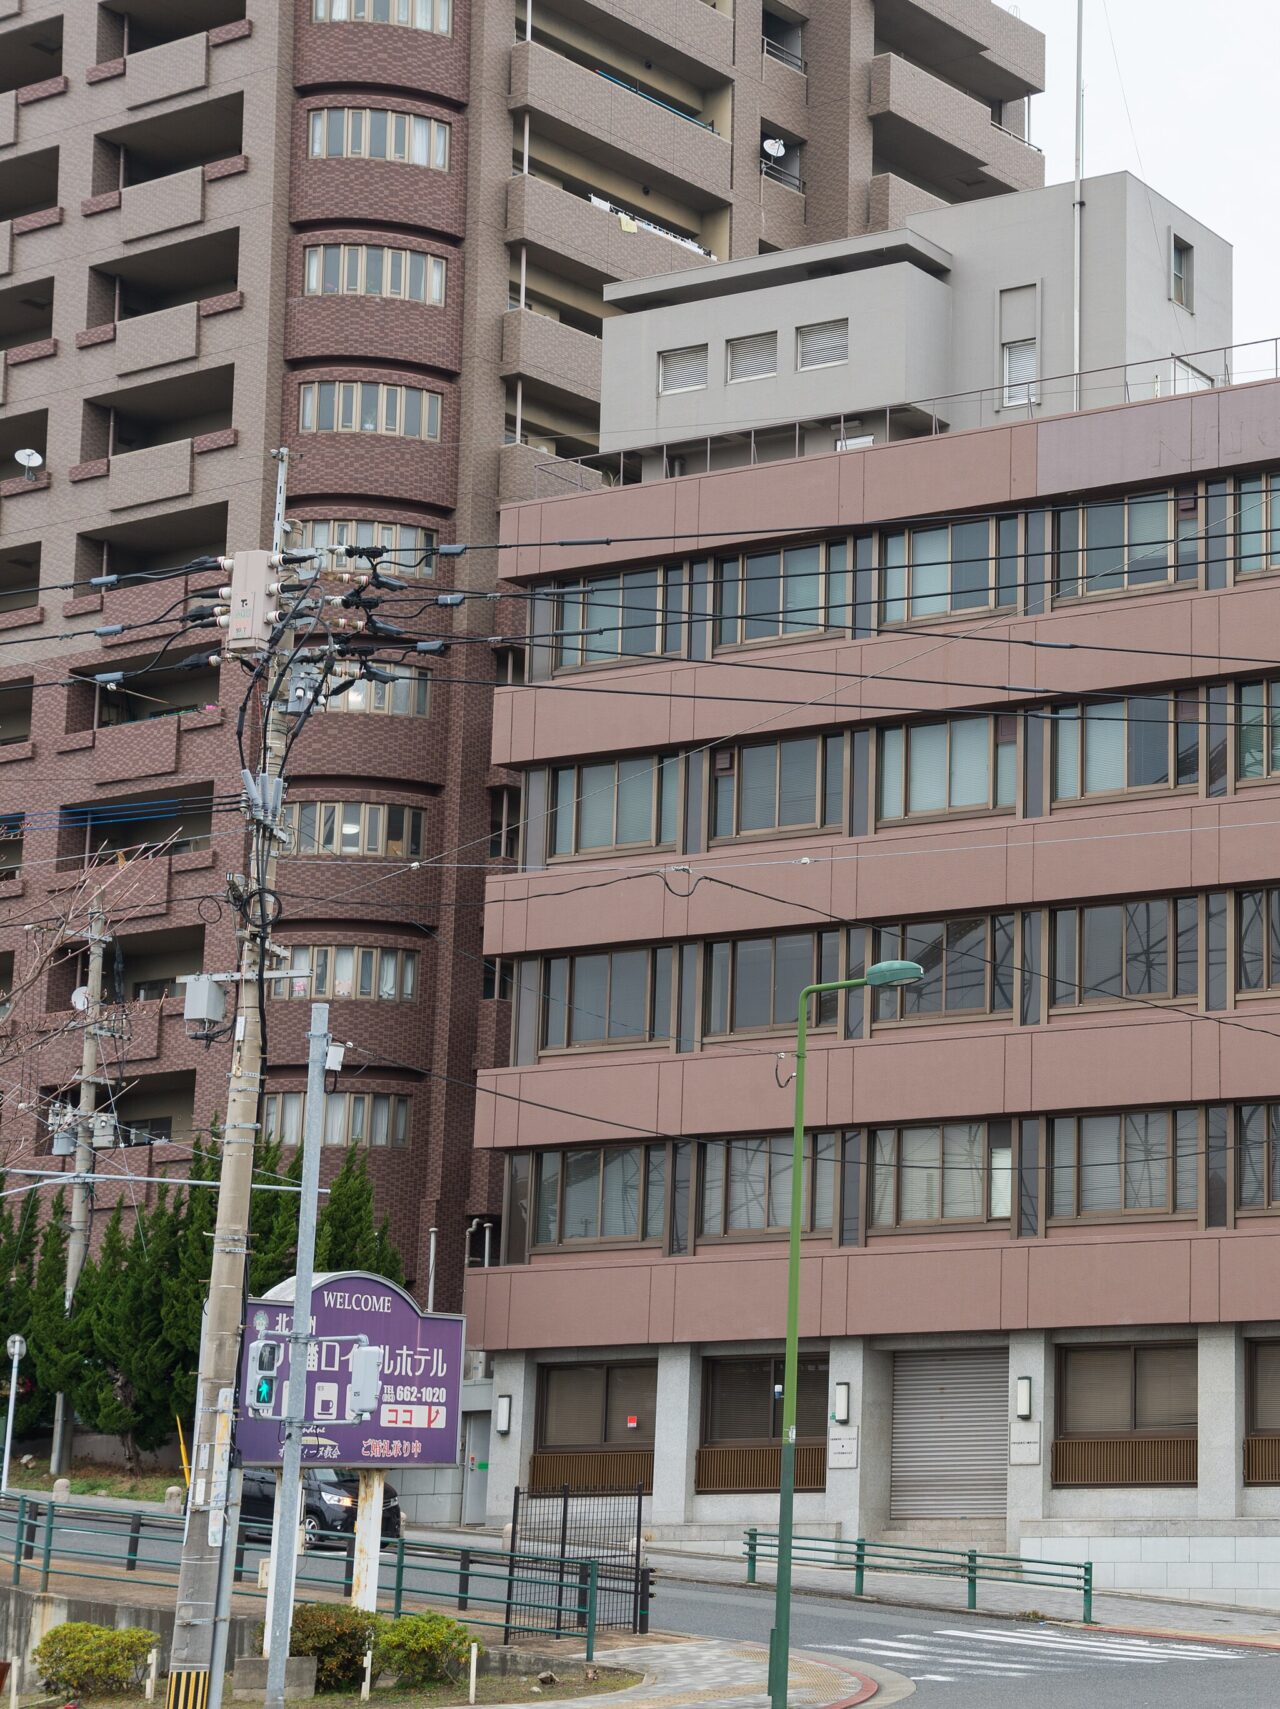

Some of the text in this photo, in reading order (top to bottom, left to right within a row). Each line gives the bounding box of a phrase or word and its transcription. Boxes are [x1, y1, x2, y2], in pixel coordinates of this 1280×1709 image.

[323, 1291, 392, 1313] WELCOME
[383, 1385, 395, 1394] TEL
[396, 1385, 447, 1403] 662-1020
[387, 1408, 413, 1425] ココ
